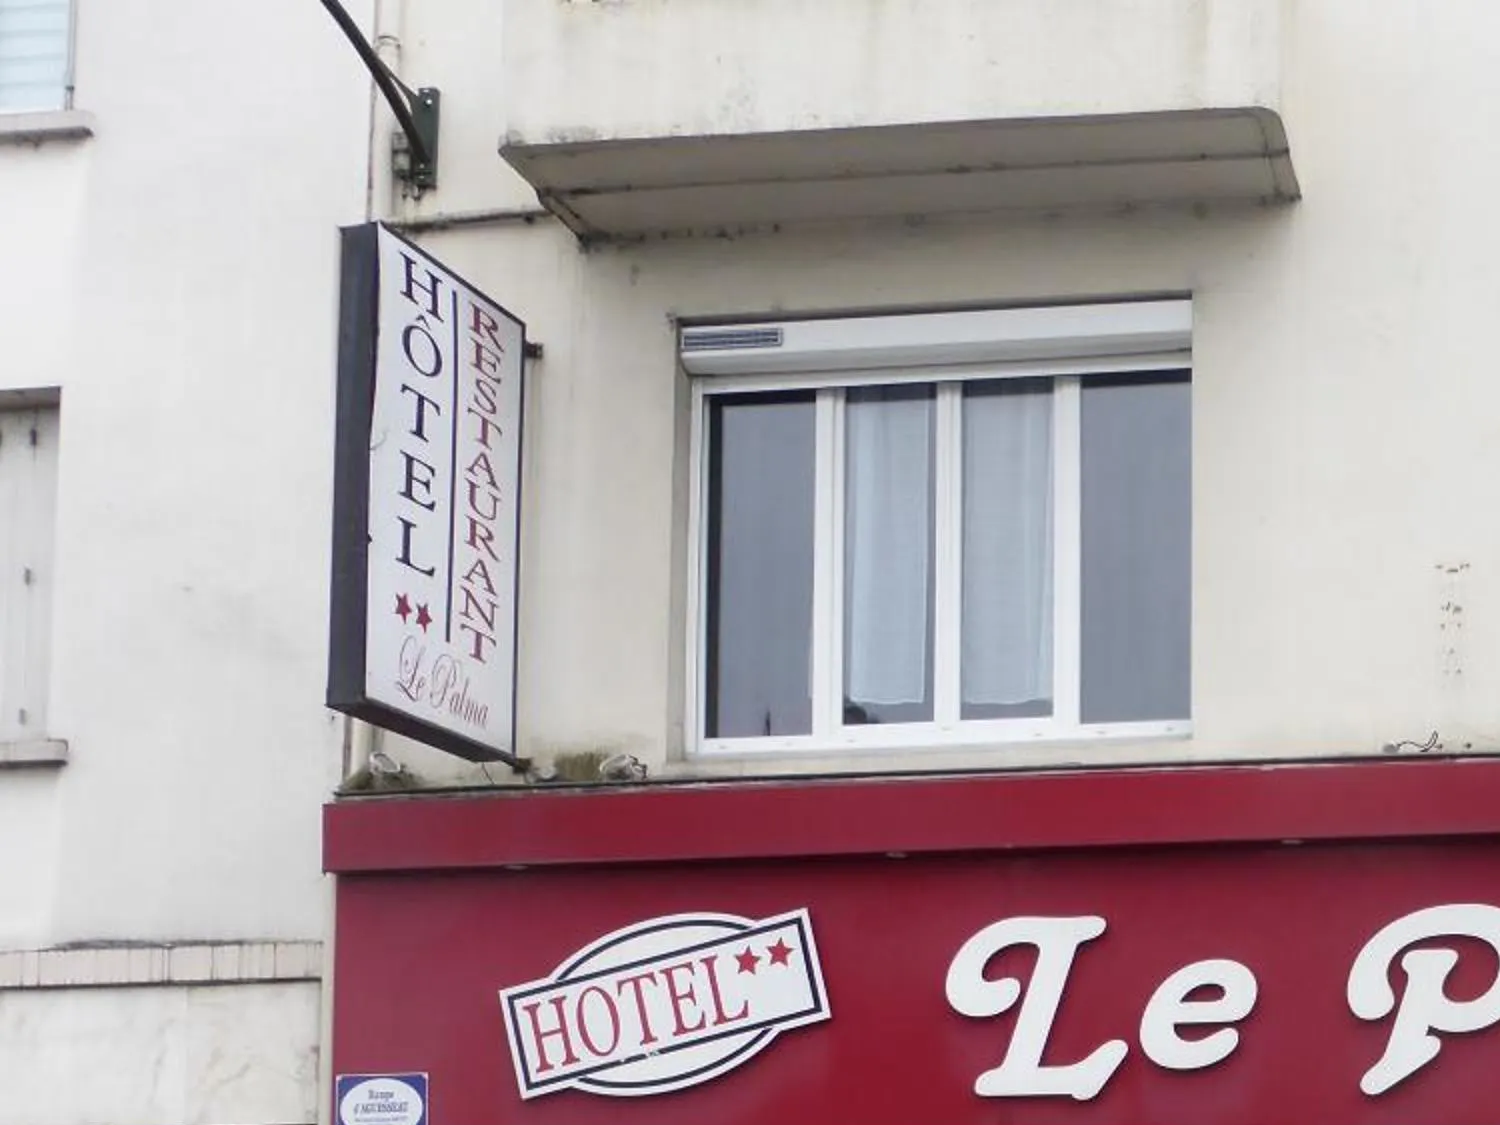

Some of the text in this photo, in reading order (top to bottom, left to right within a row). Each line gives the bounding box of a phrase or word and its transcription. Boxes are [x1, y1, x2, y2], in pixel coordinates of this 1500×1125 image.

[395, 254, 444, 577] HÔTEL
[460, 303, 502, 664] RESTAURANT
[396, 635, 489, 728] Le Palma
[522, 954, 750, 1073] HOTEL
[945, 915, 1259, 1101] Le
